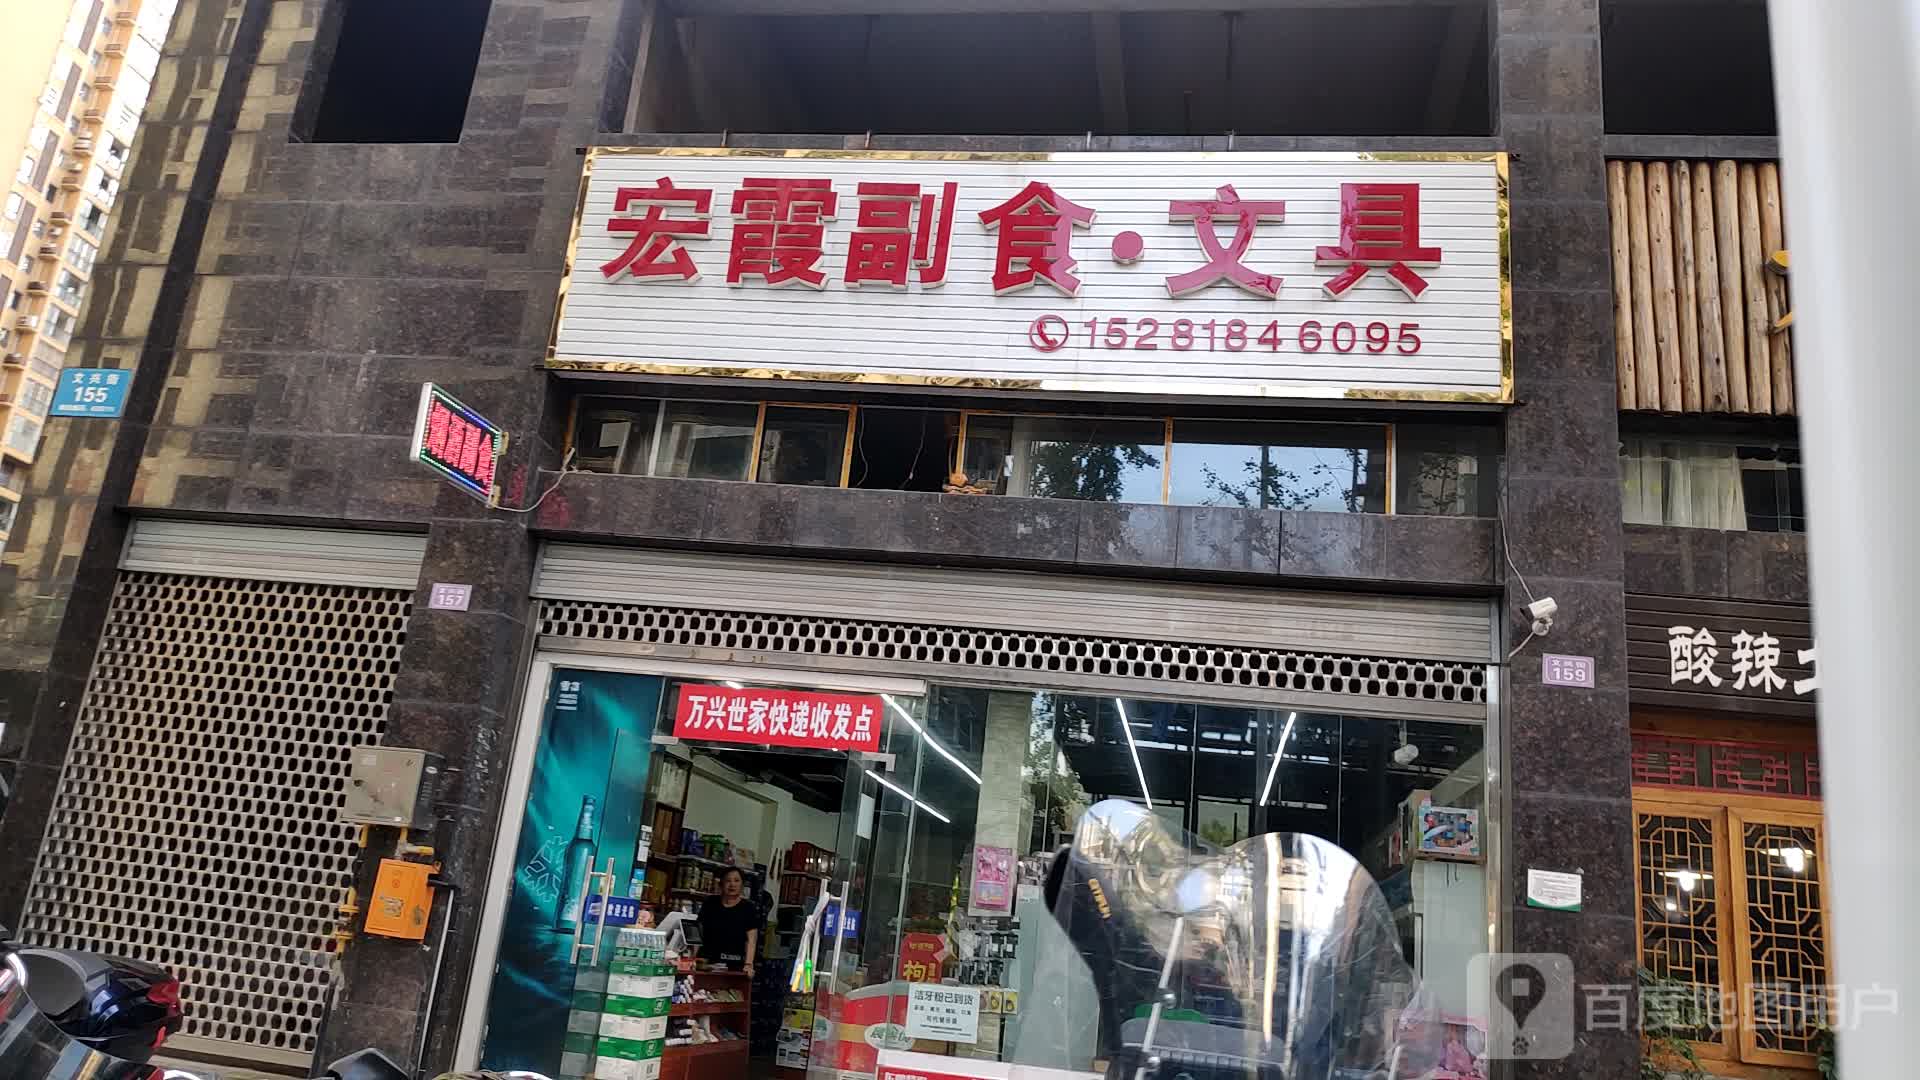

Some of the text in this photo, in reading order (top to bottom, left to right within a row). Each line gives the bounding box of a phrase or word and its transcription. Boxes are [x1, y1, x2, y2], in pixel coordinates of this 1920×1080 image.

[1084, 317, 1423, 356] 15281846095
[74, 387, 109, 402] 155
[439, 594, 465, 606] 157
[1553, 667, 1586, 681] 159
[684, 695, 874, 742] 万兴世家快递收发点
[914, 990, 974, 1005] 洁牙粉已到货
